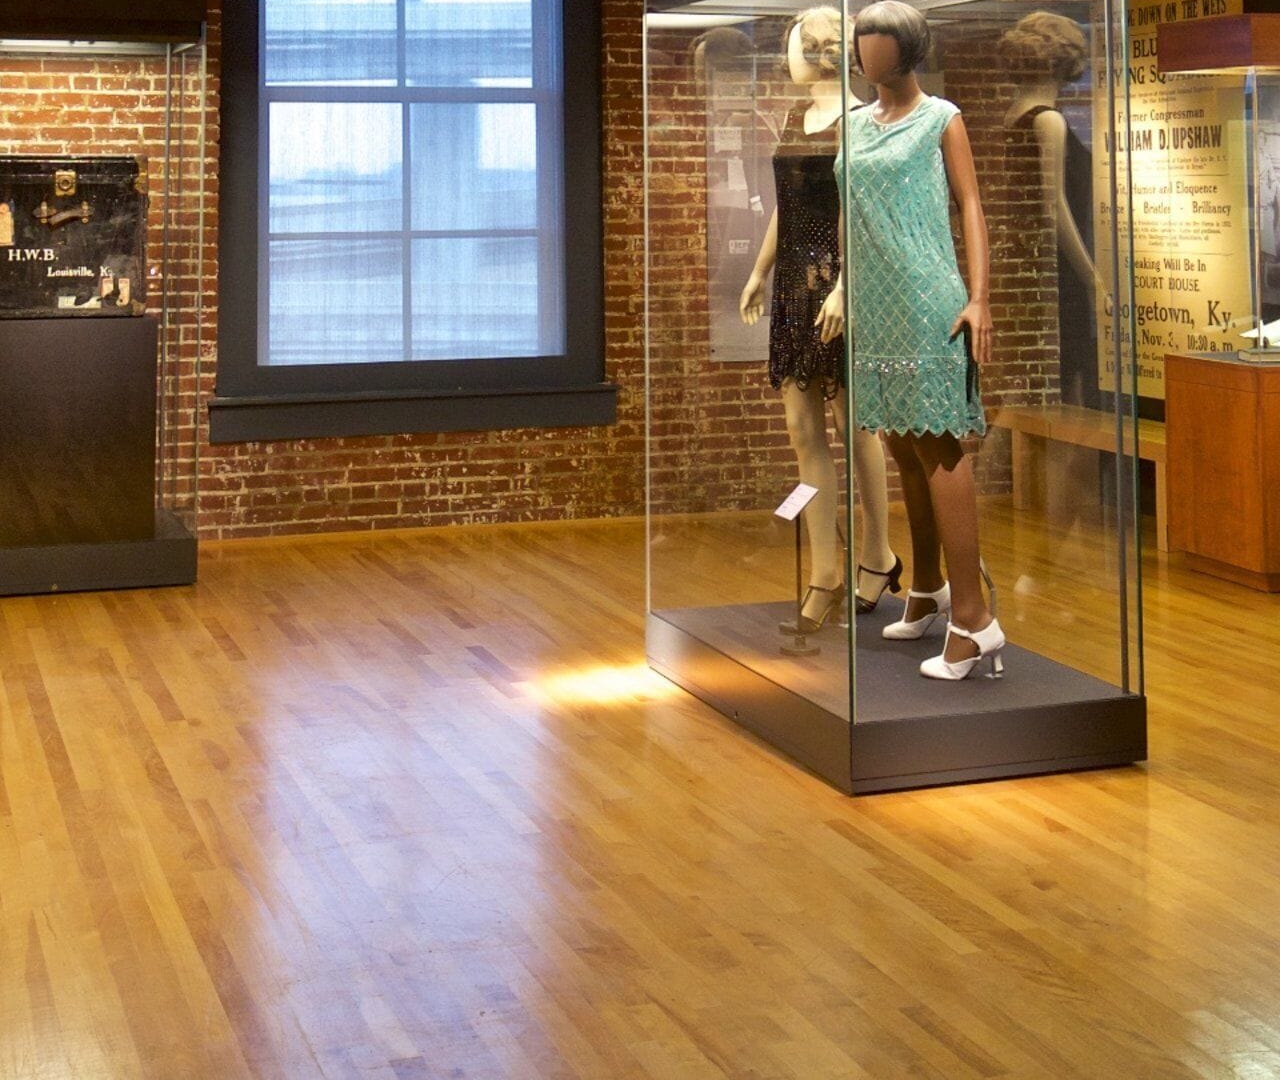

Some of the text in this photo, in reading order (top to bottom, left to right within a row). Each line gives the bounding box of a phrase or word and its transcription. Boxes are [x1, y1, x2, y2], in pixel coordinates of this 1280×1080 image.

[1138, 6, 1161, 27] DOWN
[1165, 2, 1177, 23] ON
[1150, 108, 1205, 123] Congressman
[1159, 128, 1170, 151] D.
[1173, 125, 1222, 149] UPSHAW
[1176, 181, 1218, 196] Eloquence
[1192, 200, 1231, 216] Brilliancy
[8, 248, 59, 262] H.W.B.
[1163, 258, 1181, 271] Will
[1184, 258, 1195, 272] Be
[1197, 259, 1207, 272] In
[1134, 276, 1200, 292] COURT HOUSE
[1207, 300, 1237, 334] Ky.
[1142, 329, 1166, 346] Nov.
[1187, 334, 1208, 351] 10:30
